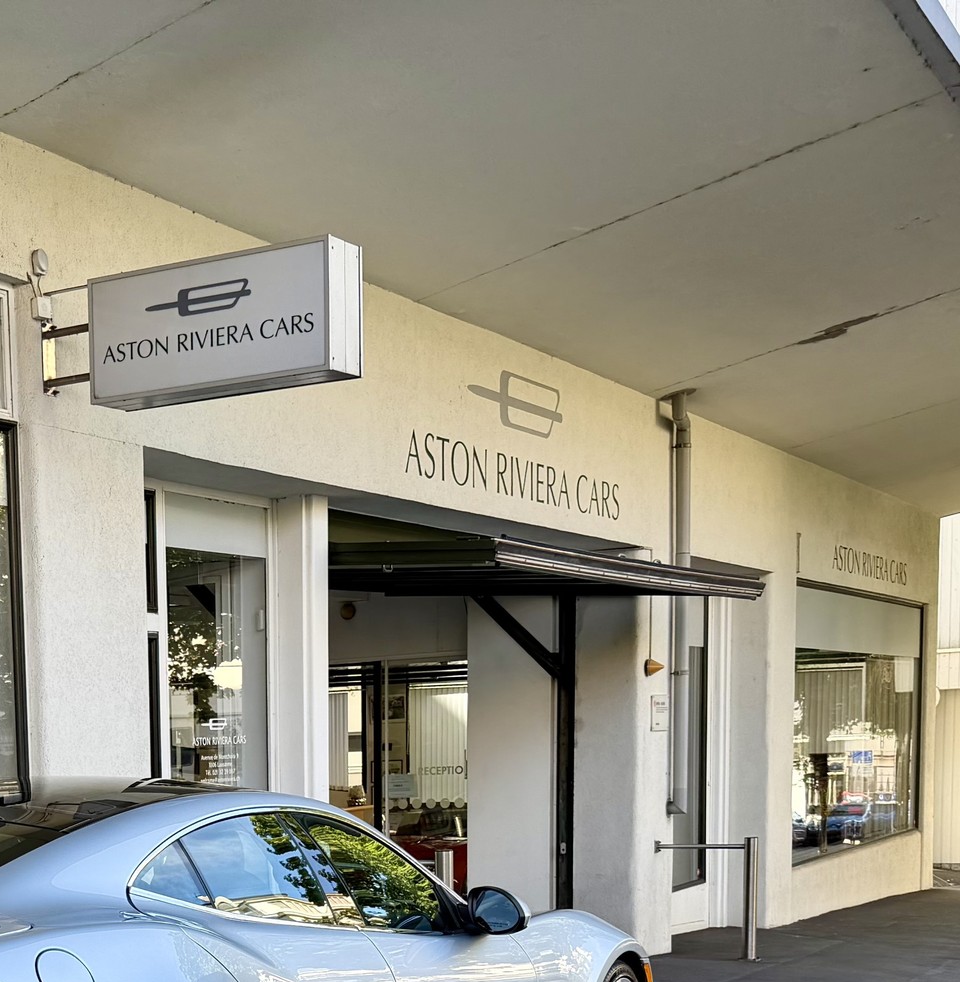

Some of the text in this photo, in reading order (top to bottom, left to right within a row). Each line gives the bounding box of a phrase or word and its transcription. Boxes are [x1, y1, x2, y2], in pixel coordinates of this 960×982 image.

[103, 313, 314, 364] ASTON RIVIERA CARS
[405, 429, 620, 521] ASTON RIVIERA CARS
[832, 545, 907, 585] ASTON RIVIERA CARS
[192, 735, 247, 746] ASTON RIVIERA CARS
[418, 765, 466, 776] RECEPTIO
